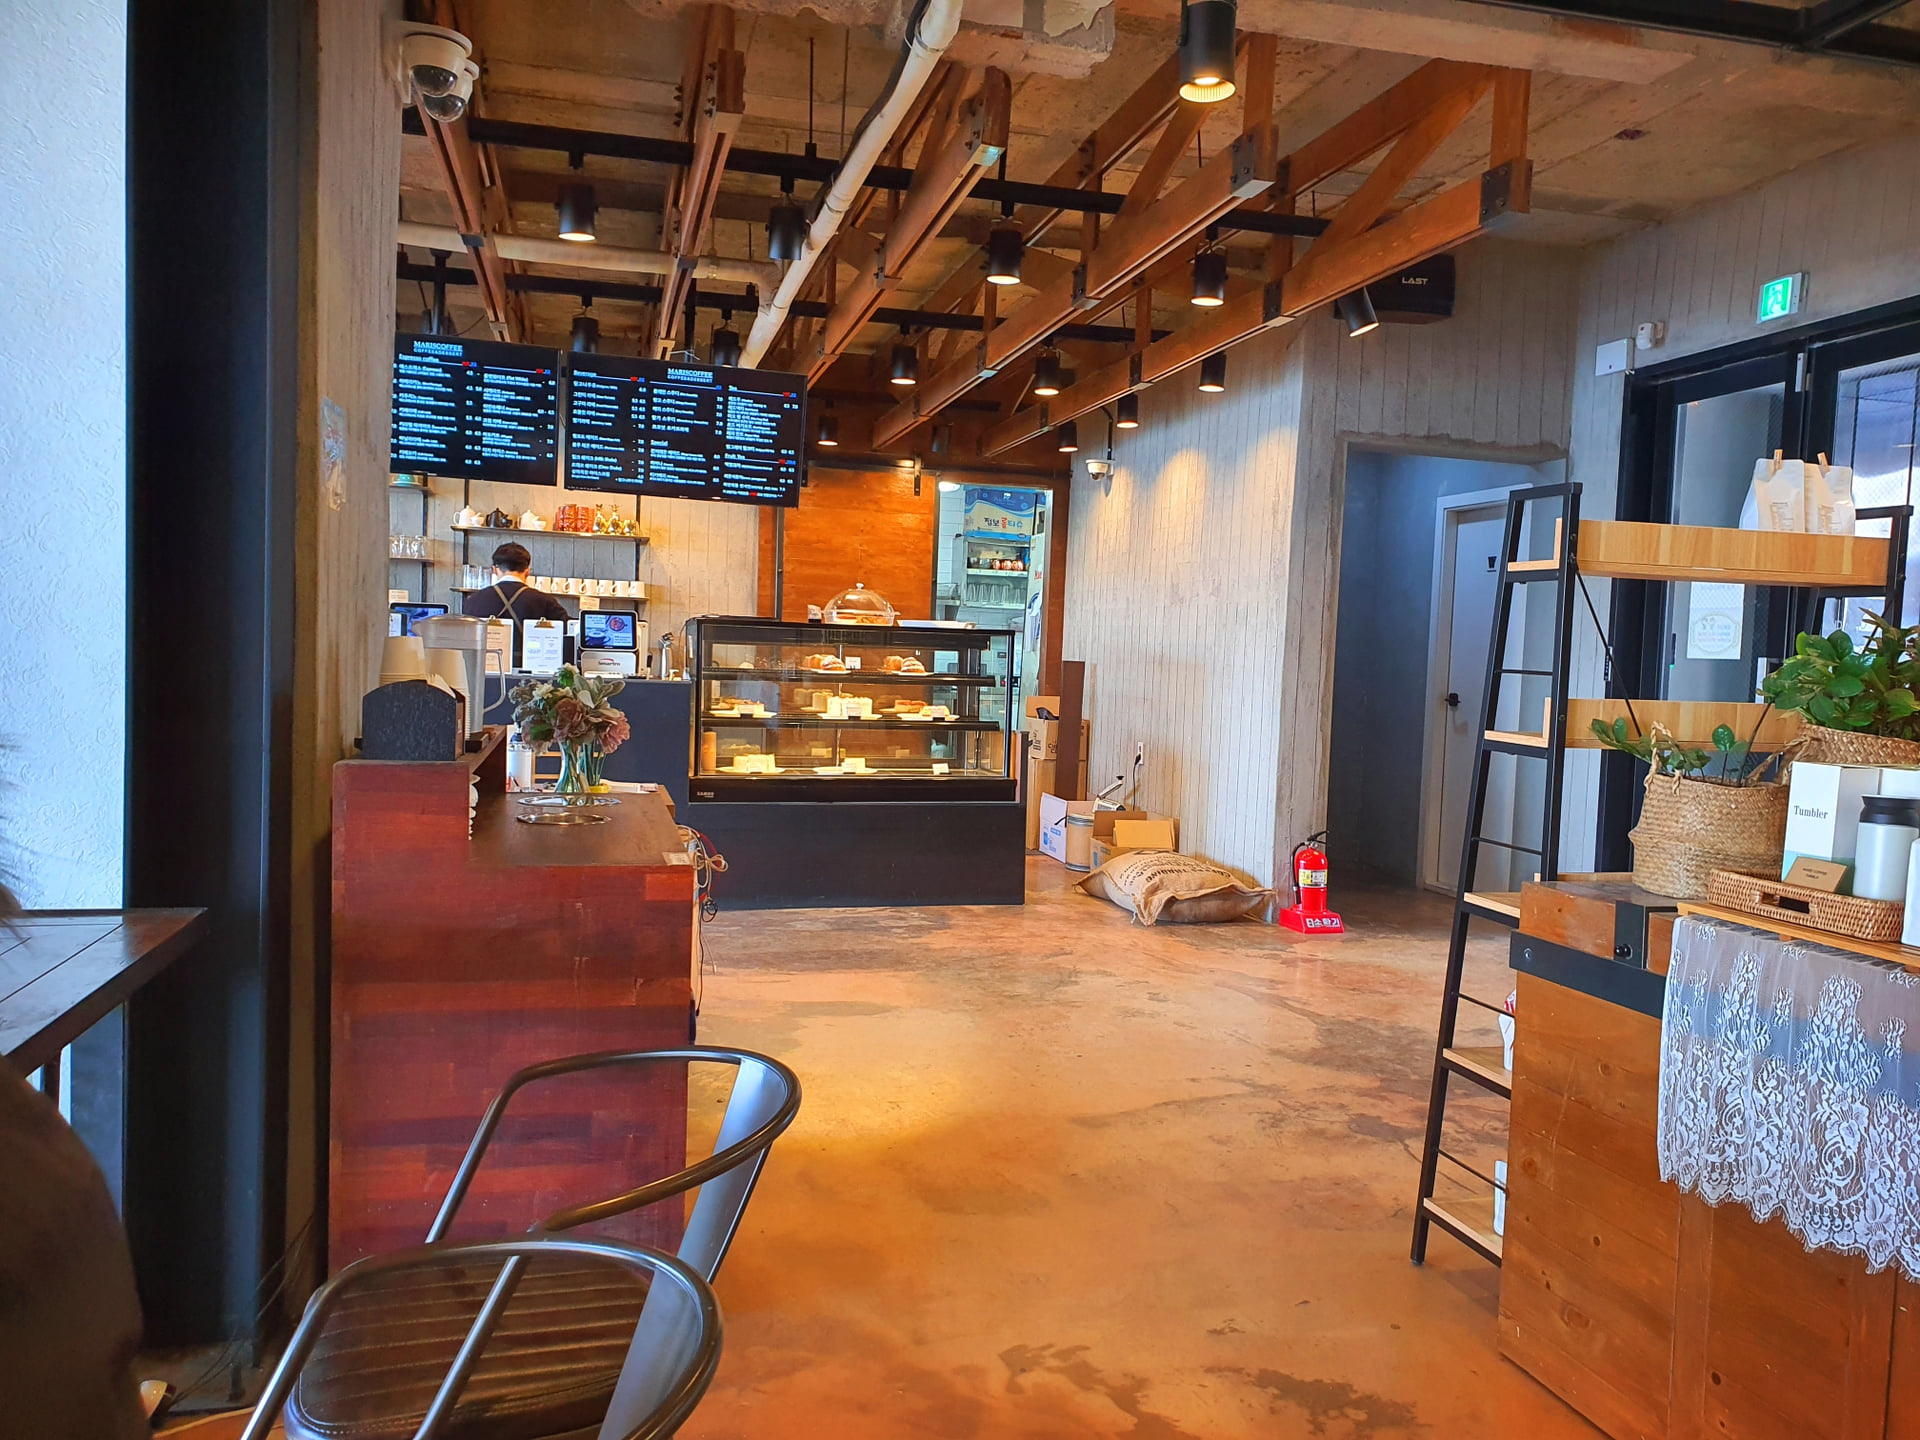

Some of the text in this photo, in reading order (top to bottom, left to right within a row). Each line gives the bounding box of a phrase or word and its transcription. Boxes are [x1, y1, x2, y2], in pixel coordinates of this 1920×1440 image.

[1401, 276, 1429, 286] LAST
[413, 341, 463, 351] MARISCOFFEE
[668, 368, 713, 378] MARISCOFFEE
[984, 517, 1023, 529] 점보 롤티슈
[1793, 805, 1829, 819] Tumbler
